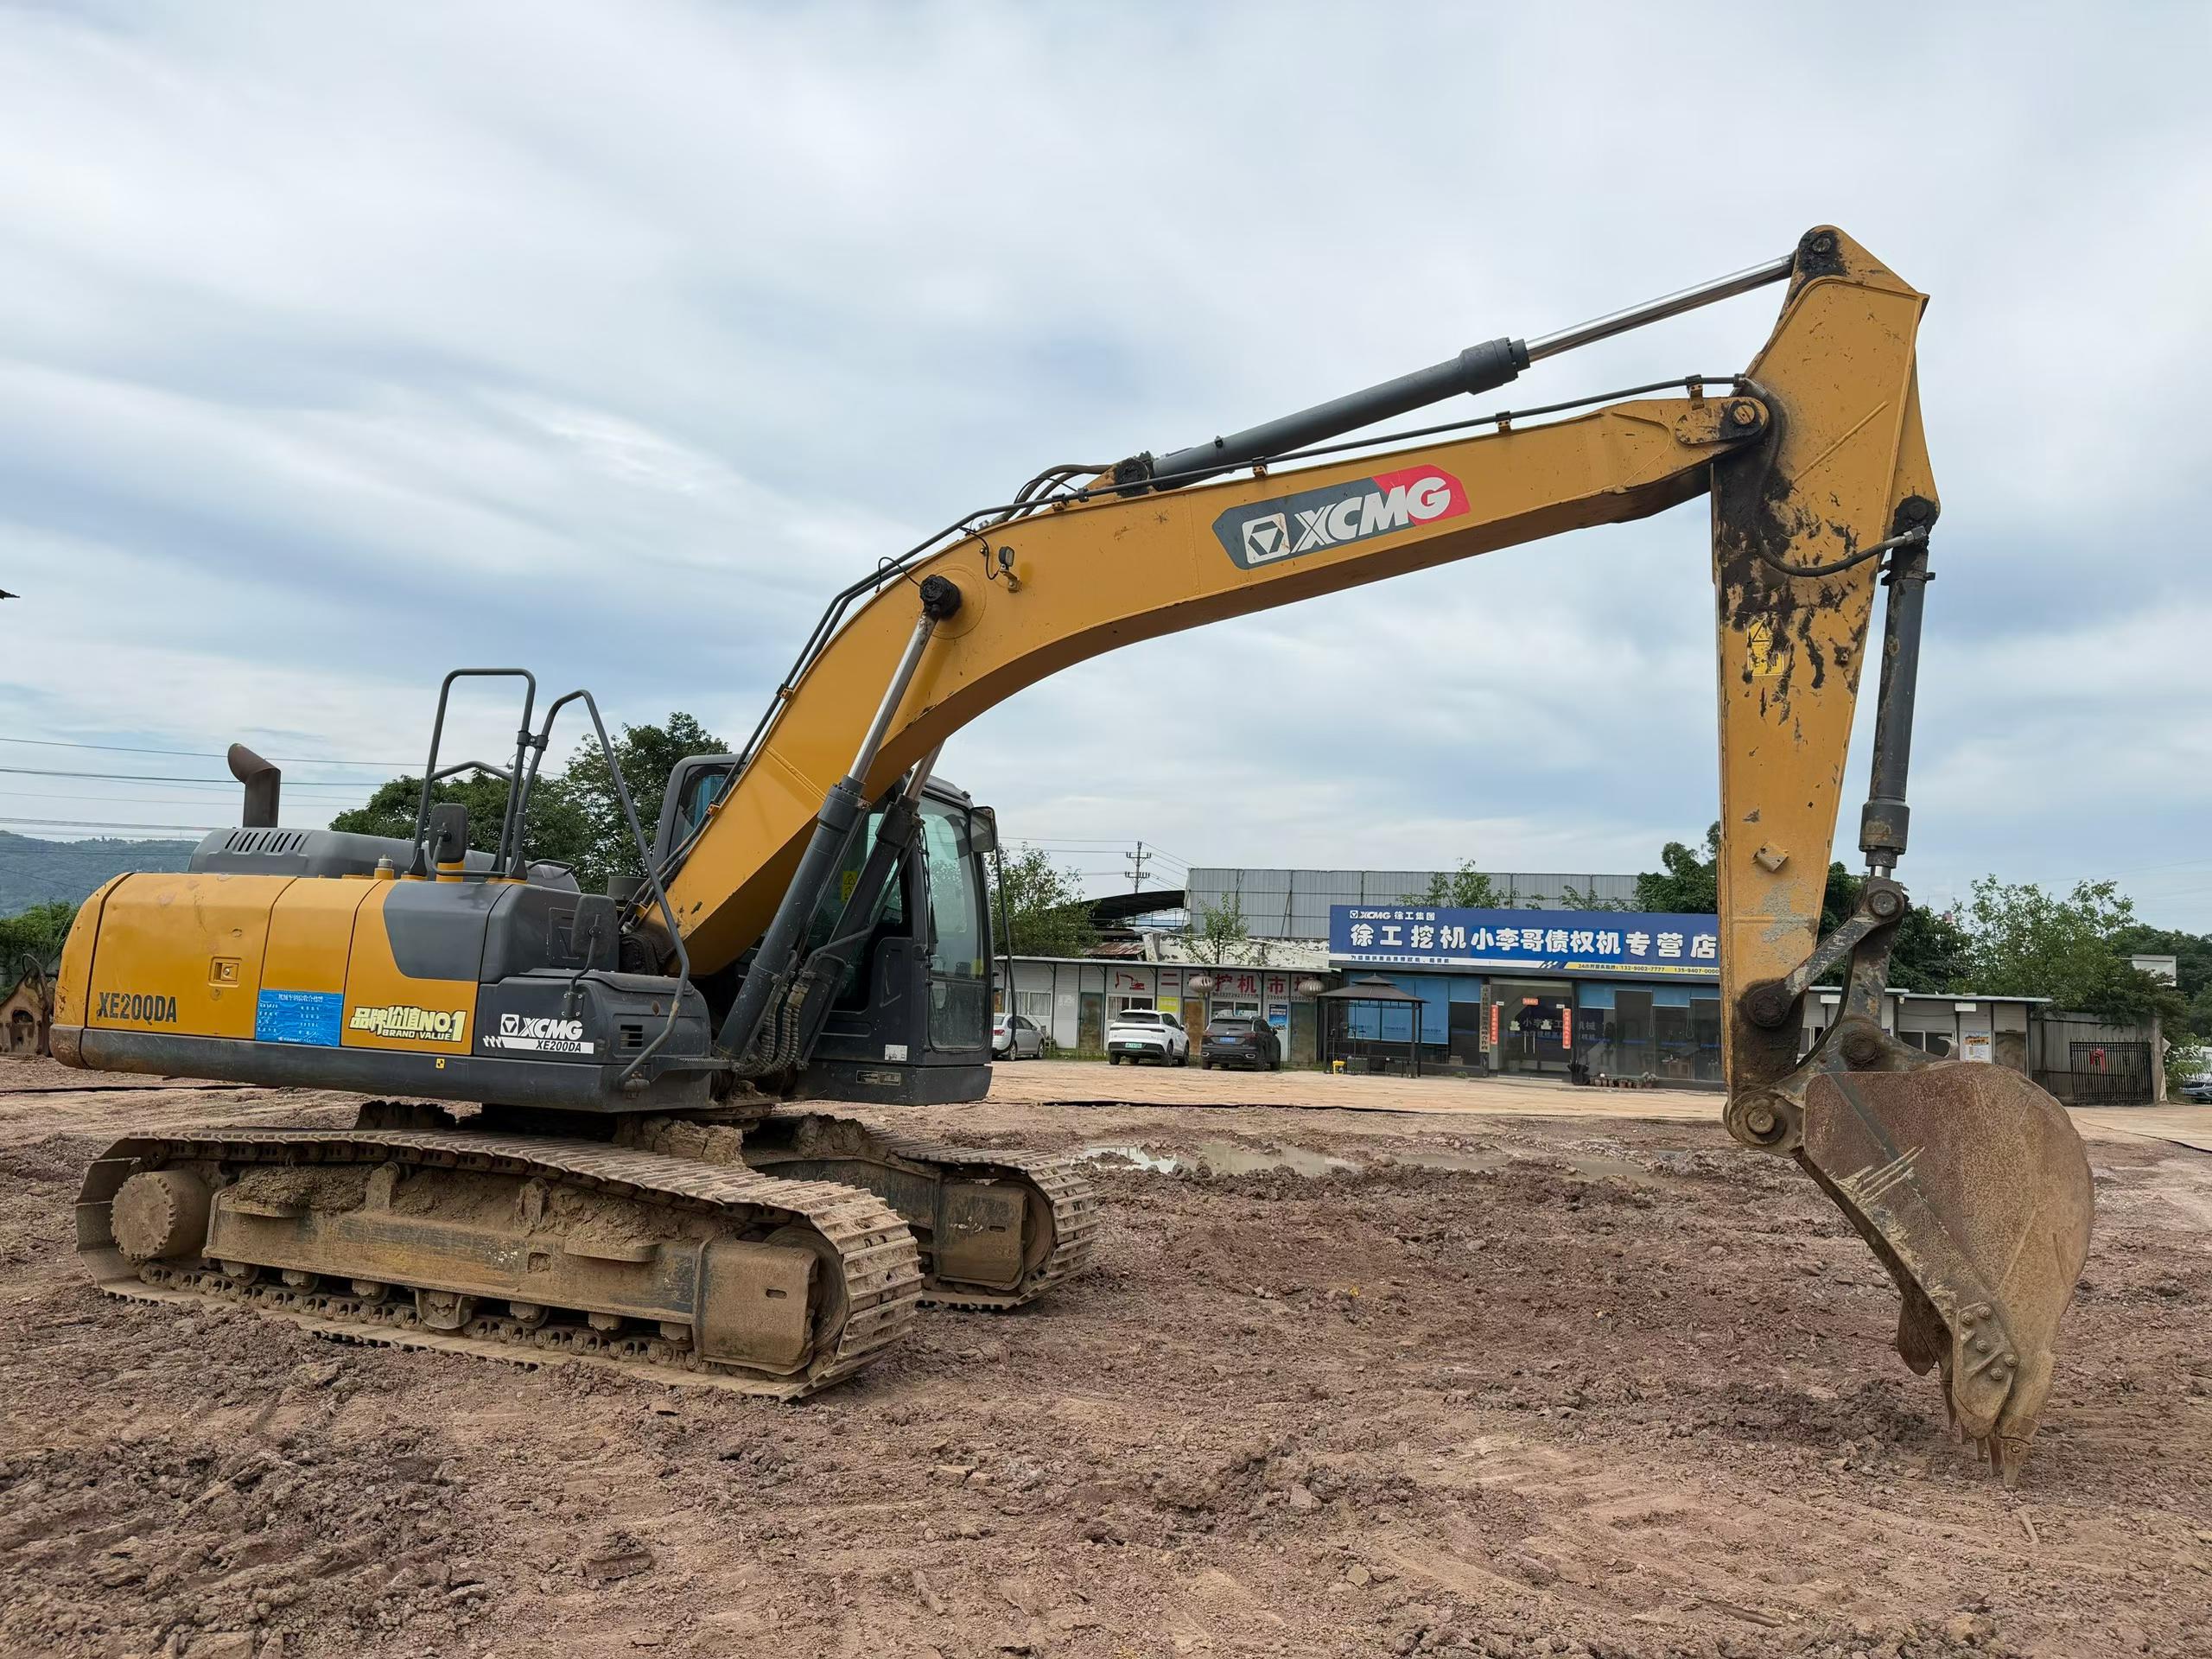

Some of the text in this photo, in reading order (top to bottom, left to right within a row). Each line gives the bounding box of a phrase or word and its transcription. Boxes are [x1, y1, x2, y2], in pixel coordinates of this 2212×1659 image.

[1290, 477, 1451, 554] XCMG
[382, 1028, 453, 1040] BRAND VALUE
[518, 1017, 583, 1040] XCMG
[536, 1039, 582, 1052] XE200DA
